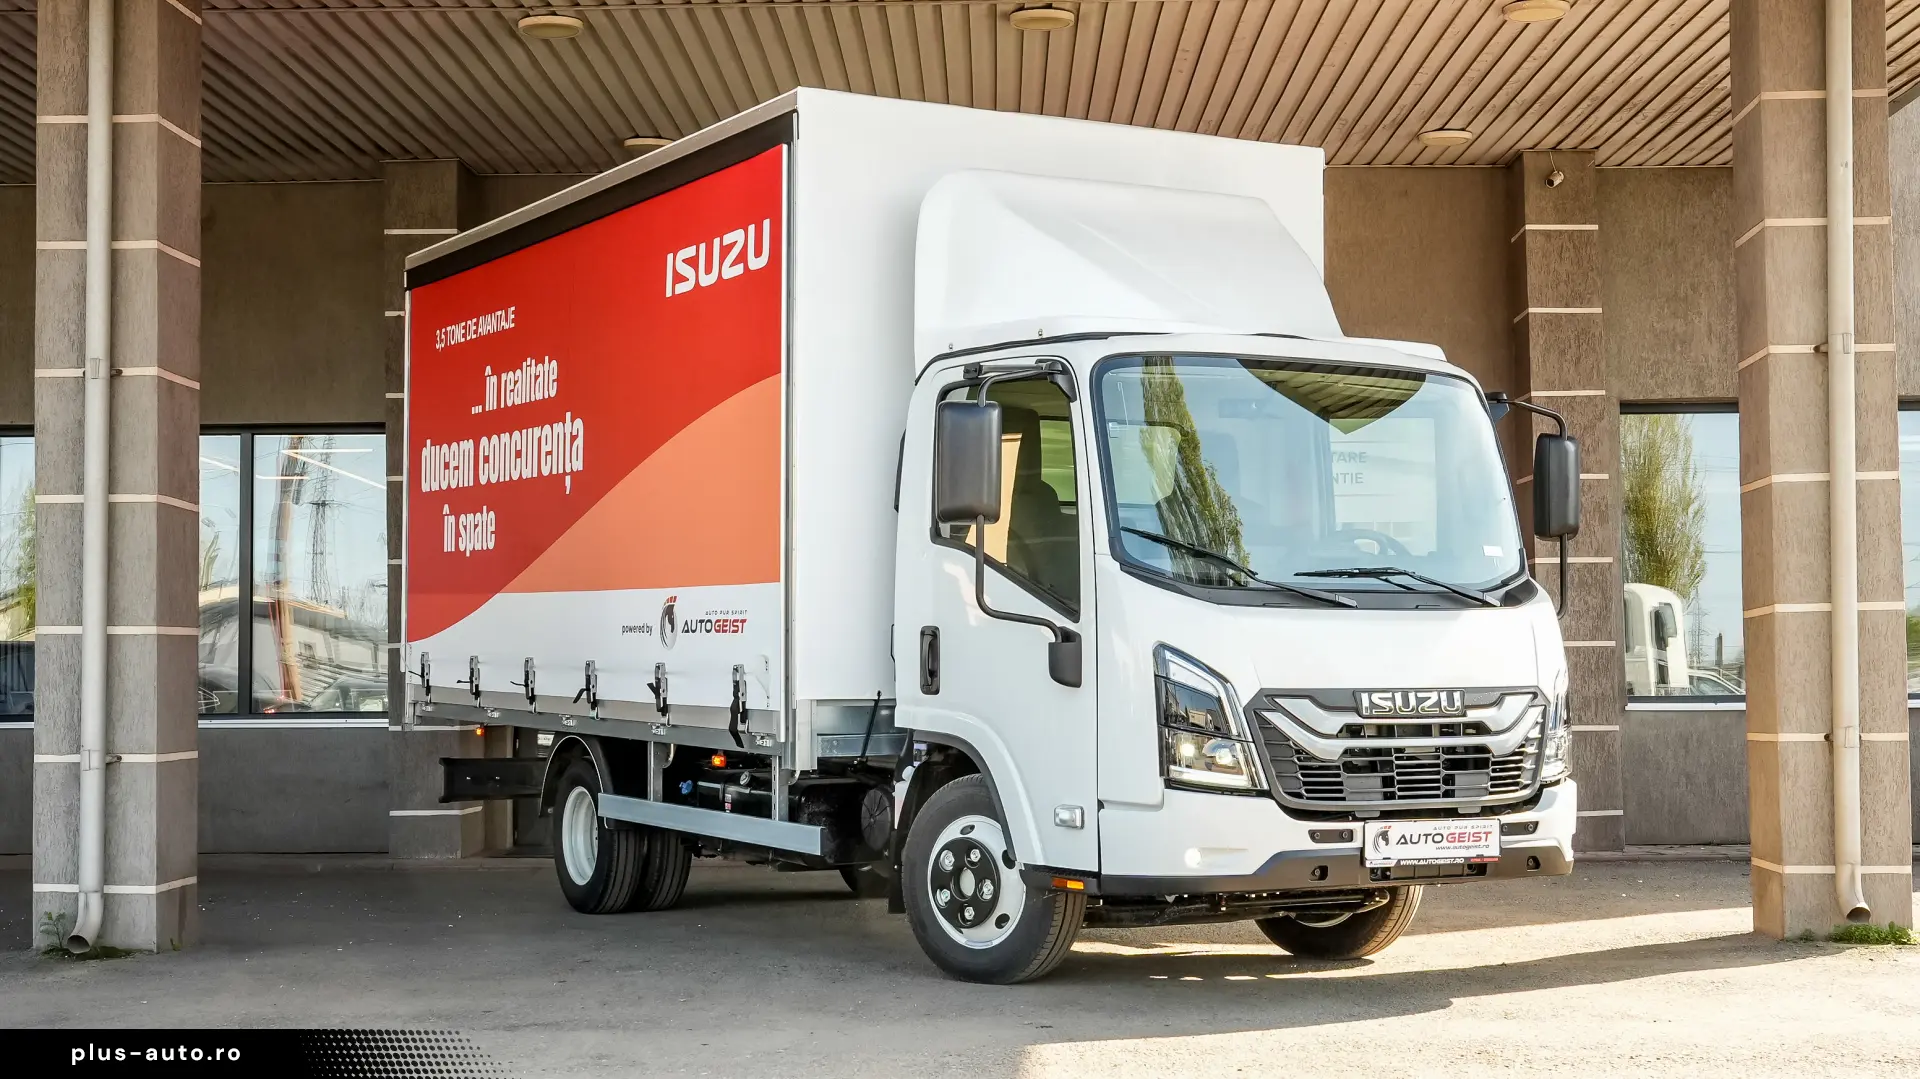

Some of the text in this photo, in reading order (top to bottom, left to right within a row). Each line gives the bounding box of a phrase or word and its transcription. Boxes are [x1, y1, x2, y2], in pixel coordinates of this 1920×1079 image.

[665, 218, 771, 298] ISUZU
[435, 305, 516, 352] 3,5 TONE DE AVANTAJE
[484, 365, 498, 412] în
[500, 355, 558, 409] realitate
[421, 411, 584, 495] ducem concurența
[442, 503, 496, 557] în spate
[621, 622, 653, 636] powered by
[681, 619, 747, 633] AUTOGEIST
[1361, 691, 1461, 715] ISUZU
[1396, 831, 1493, 846] AUTOGEIST
[1400, 857, 1465, 866] WWW.AUTOGEIST.RO
